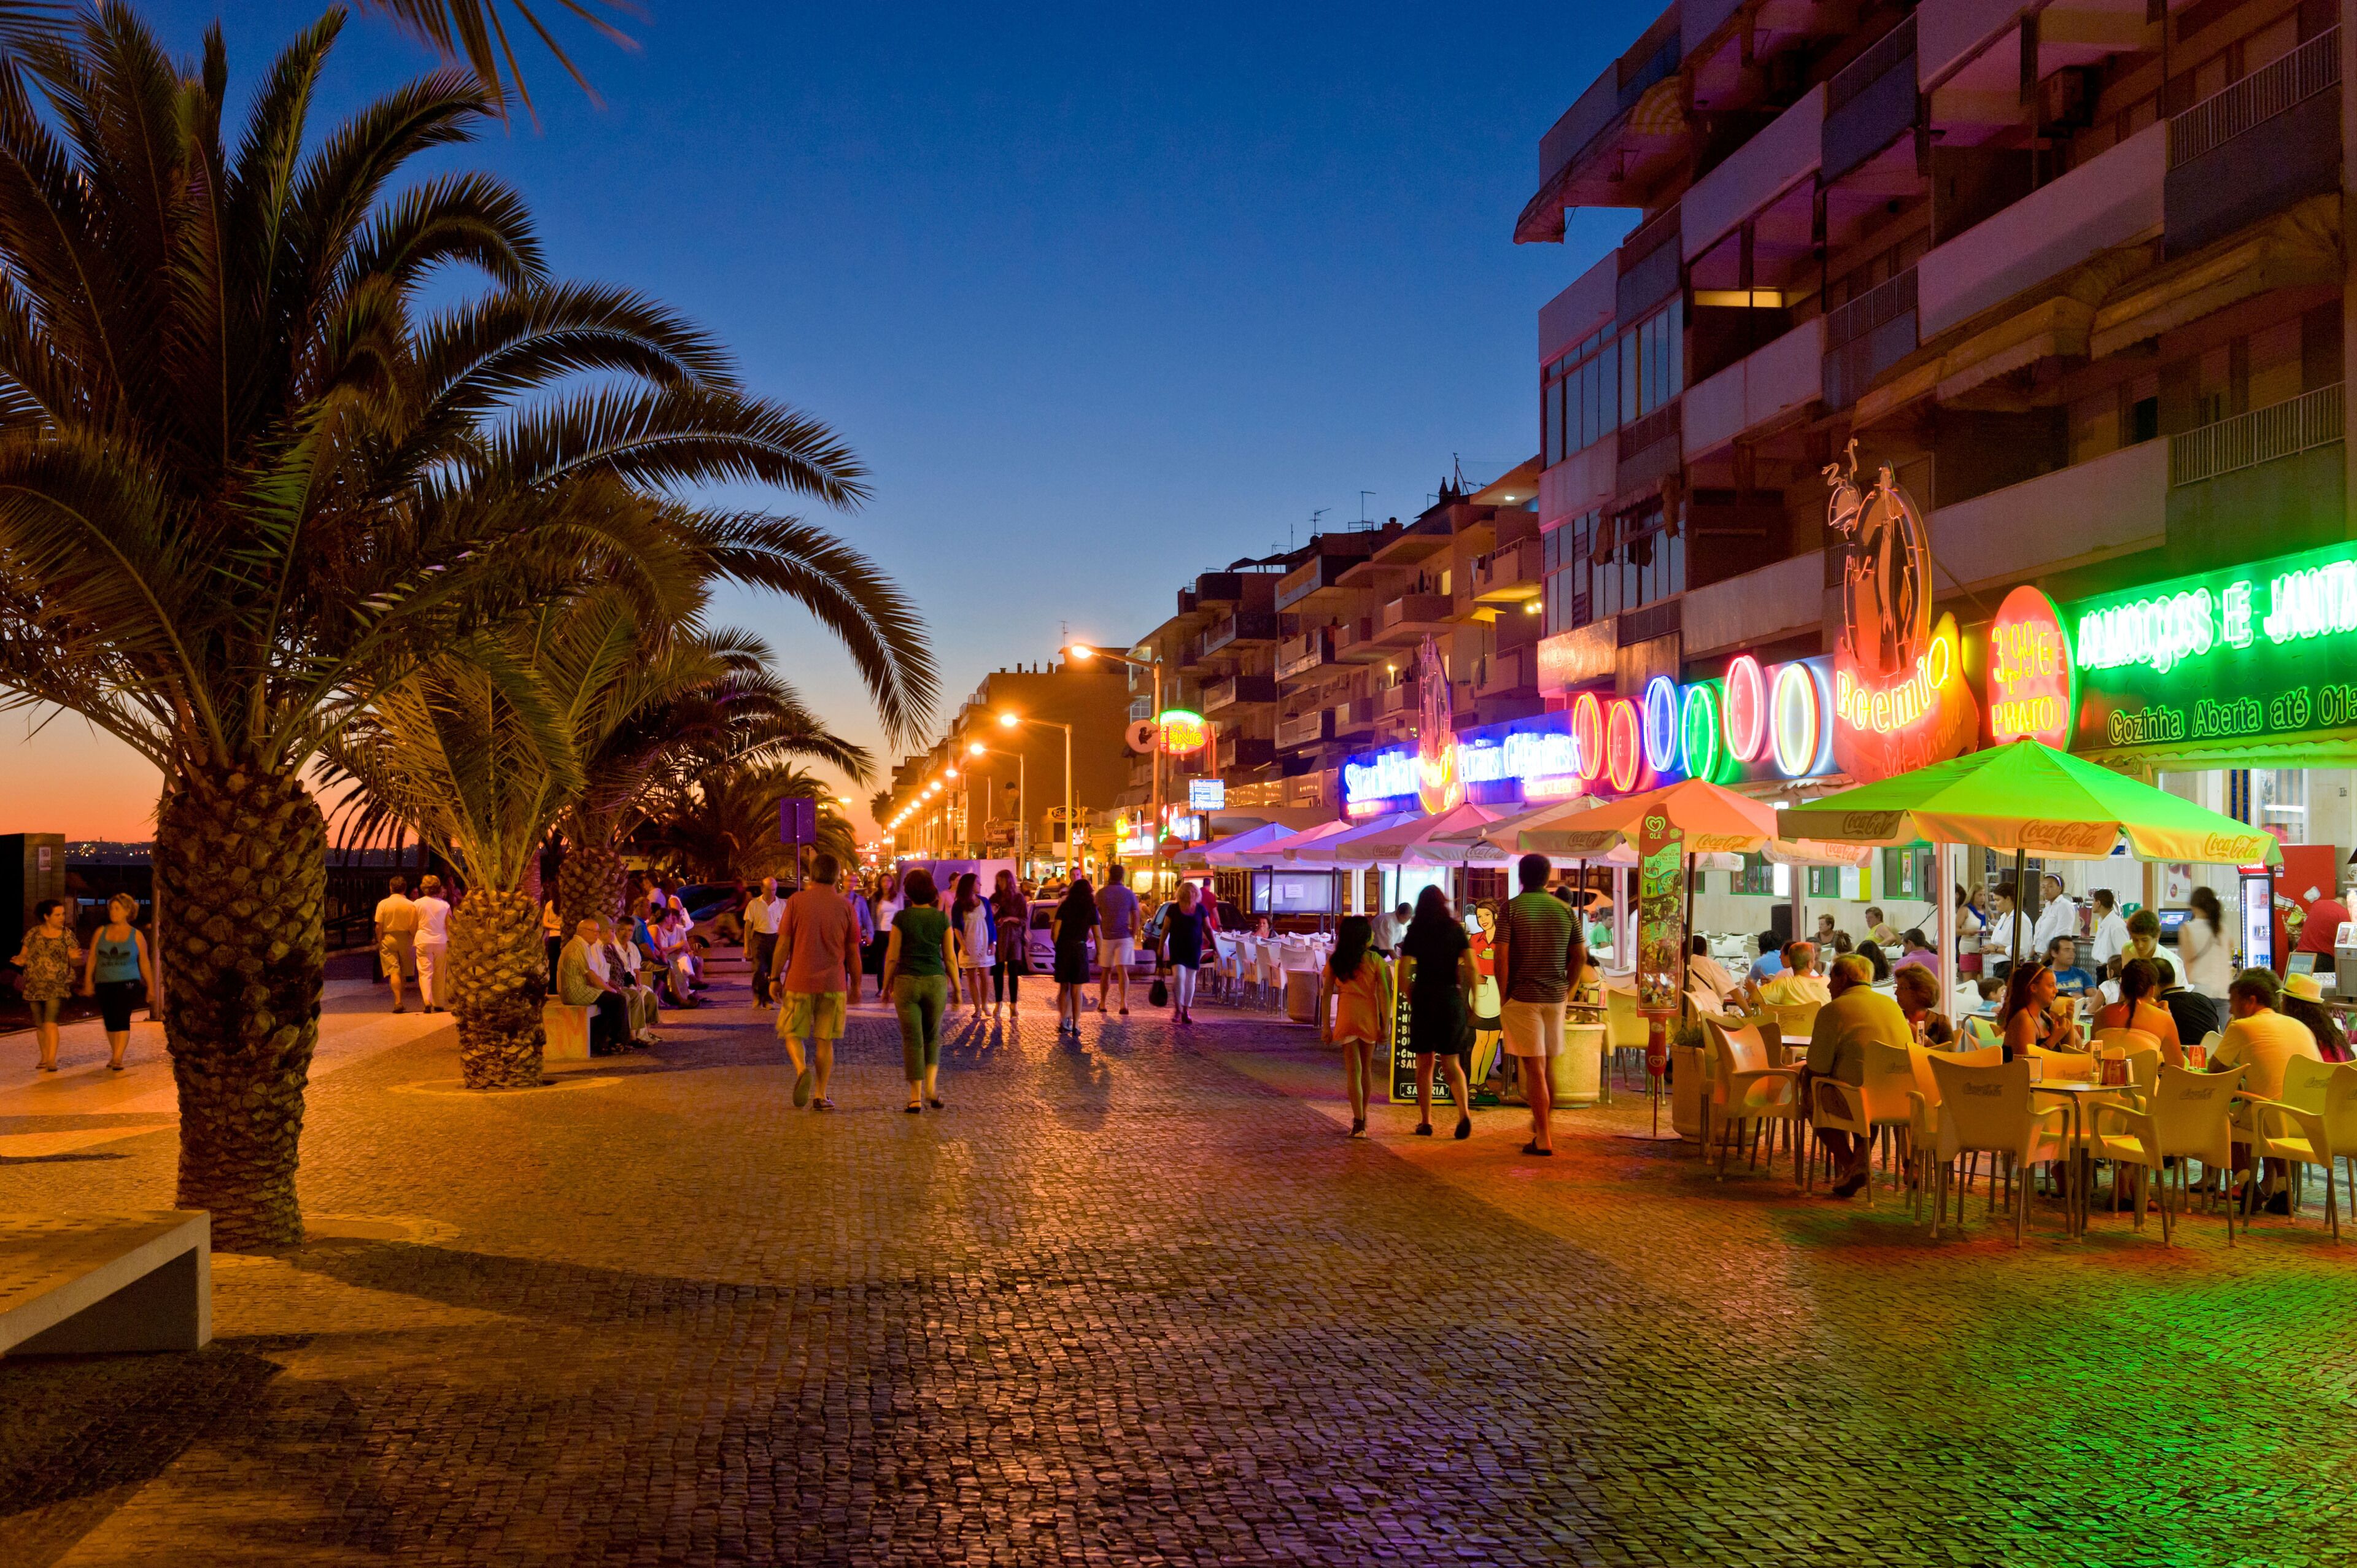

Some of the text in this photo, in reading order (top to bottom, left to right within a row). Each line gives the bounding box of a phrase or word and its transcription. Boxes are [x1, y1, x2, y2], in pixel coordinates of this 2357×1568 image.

[2223, 580, 2254, 649] E
[1836, 636, 1949, 733] Boemio
[1991, 695, 2054, 736] PRATO
[2108, 706, 2185, 746] Cozinha
[2192, 698, 2262, 736] Aberta
[2270, 686, 2310, 730] até
[2018, 819, 2105, 848] Coca-Cola
[2204, 832, 2260, 859] Coca-Cola
